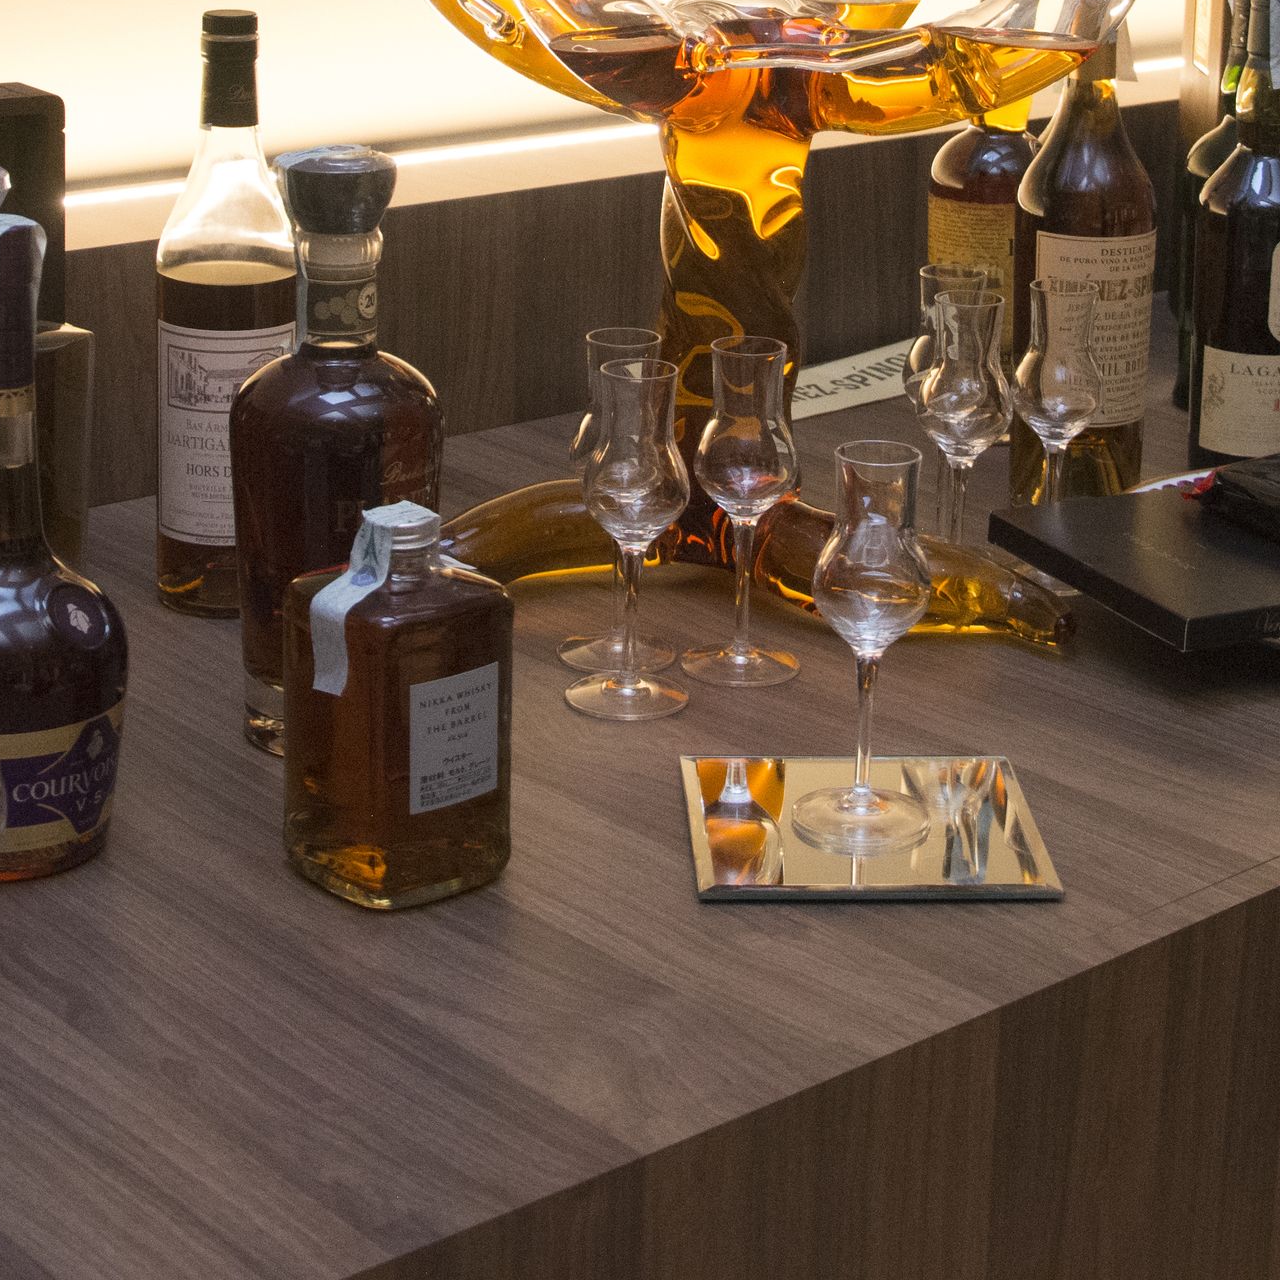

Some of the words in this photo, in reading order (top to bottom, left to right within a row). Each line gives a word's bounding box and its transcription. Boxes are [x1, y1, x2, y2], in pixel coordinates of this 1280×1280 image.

[186, 463, 220, 478] HORS
[420, 695, 453, 709] NIKKA
[456, 681, 492, 699] WHISKY
[444, 703, 471, 716] FROM
[427, 722, 447, 735] THE
[450, 712, 488, 730] BARREL
